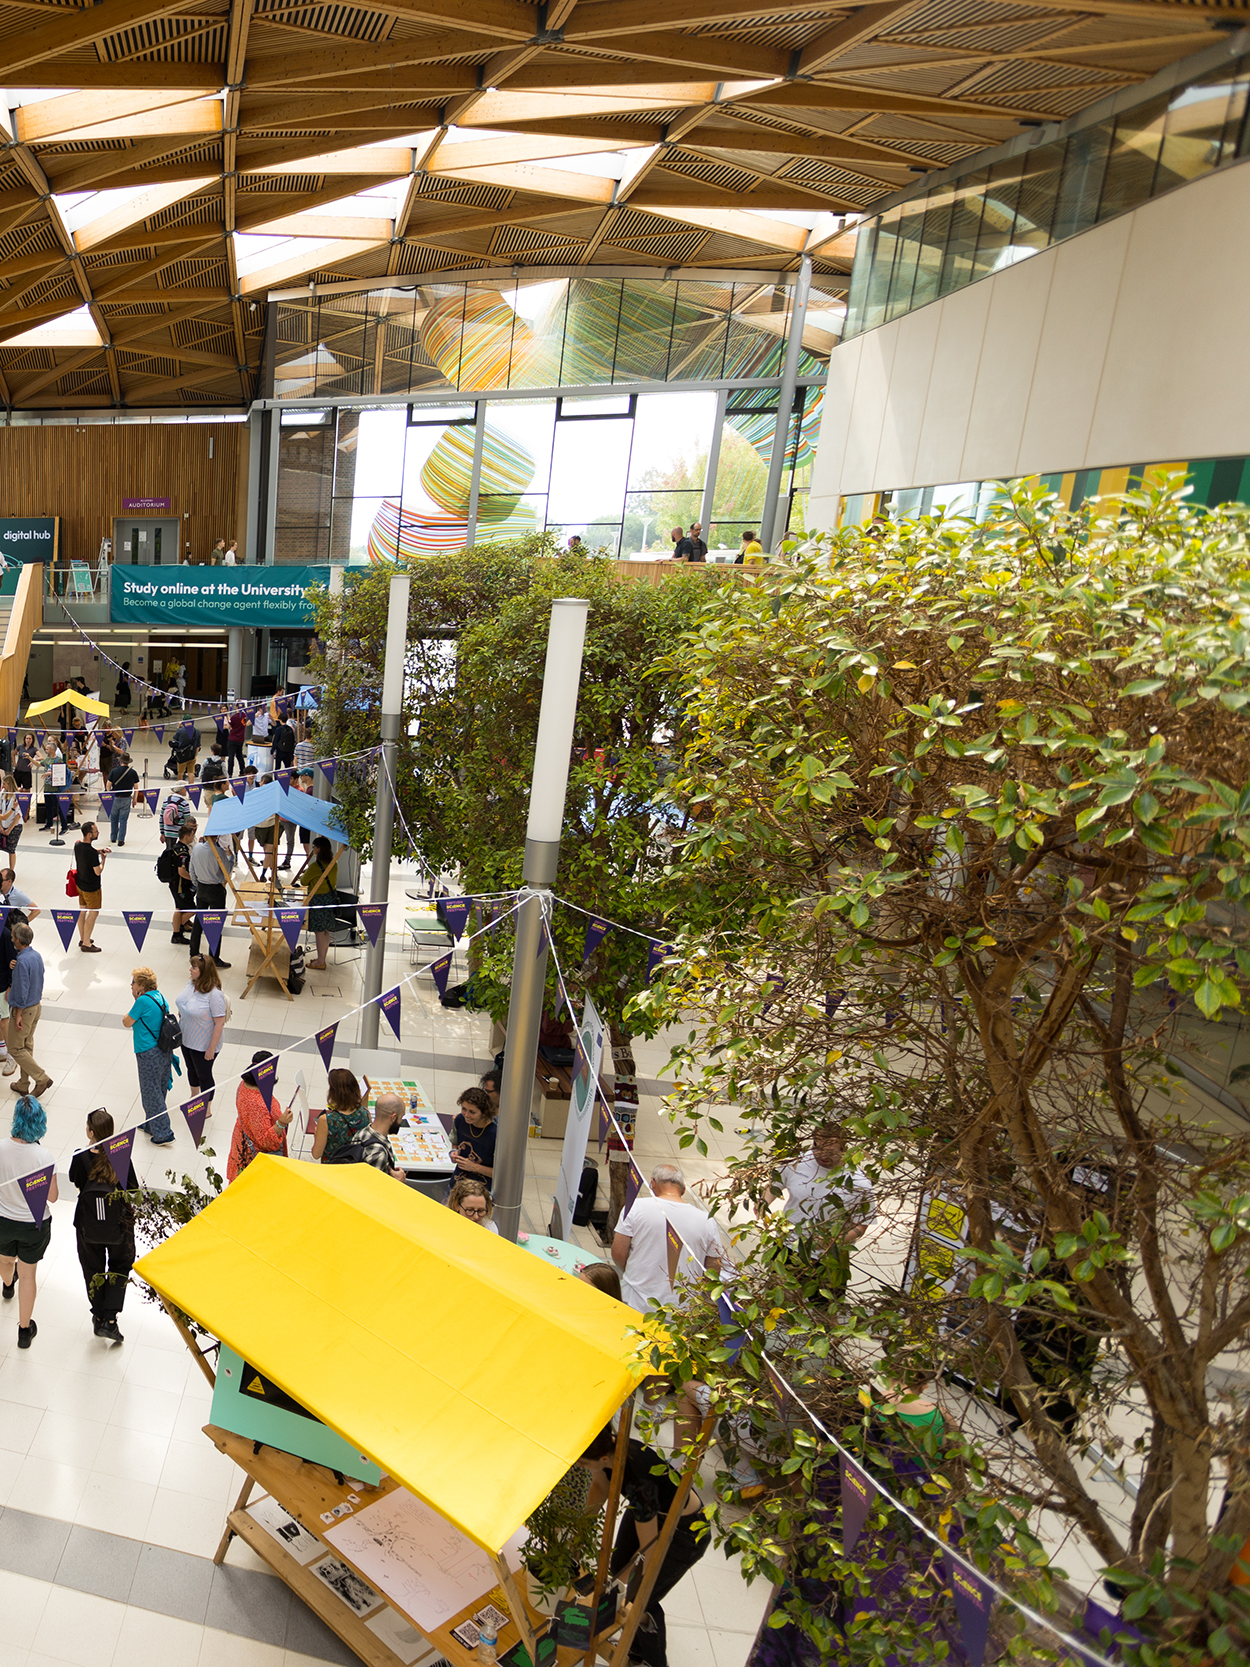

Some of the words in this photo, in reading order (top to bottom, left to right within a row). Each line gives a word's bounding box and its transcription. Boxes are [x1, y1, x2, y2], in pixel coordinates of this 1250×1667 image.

[3, 530, 32, 542] digital
[33, 530, 51, 540] hub
[124, 582, 158, 596] Study
[160, 583, 199, 594] online
[201, 584, 215, 595] at
[217, 583, 239, 595] the
[242, 584, 308, 598] University
[124, 597, 158, 606] Become
[168, 599, 196, 609] global
[198, 599, 231, 610] change
[234, 600, 261, 611] agent
[263, 600, 296, 611] flexibly
